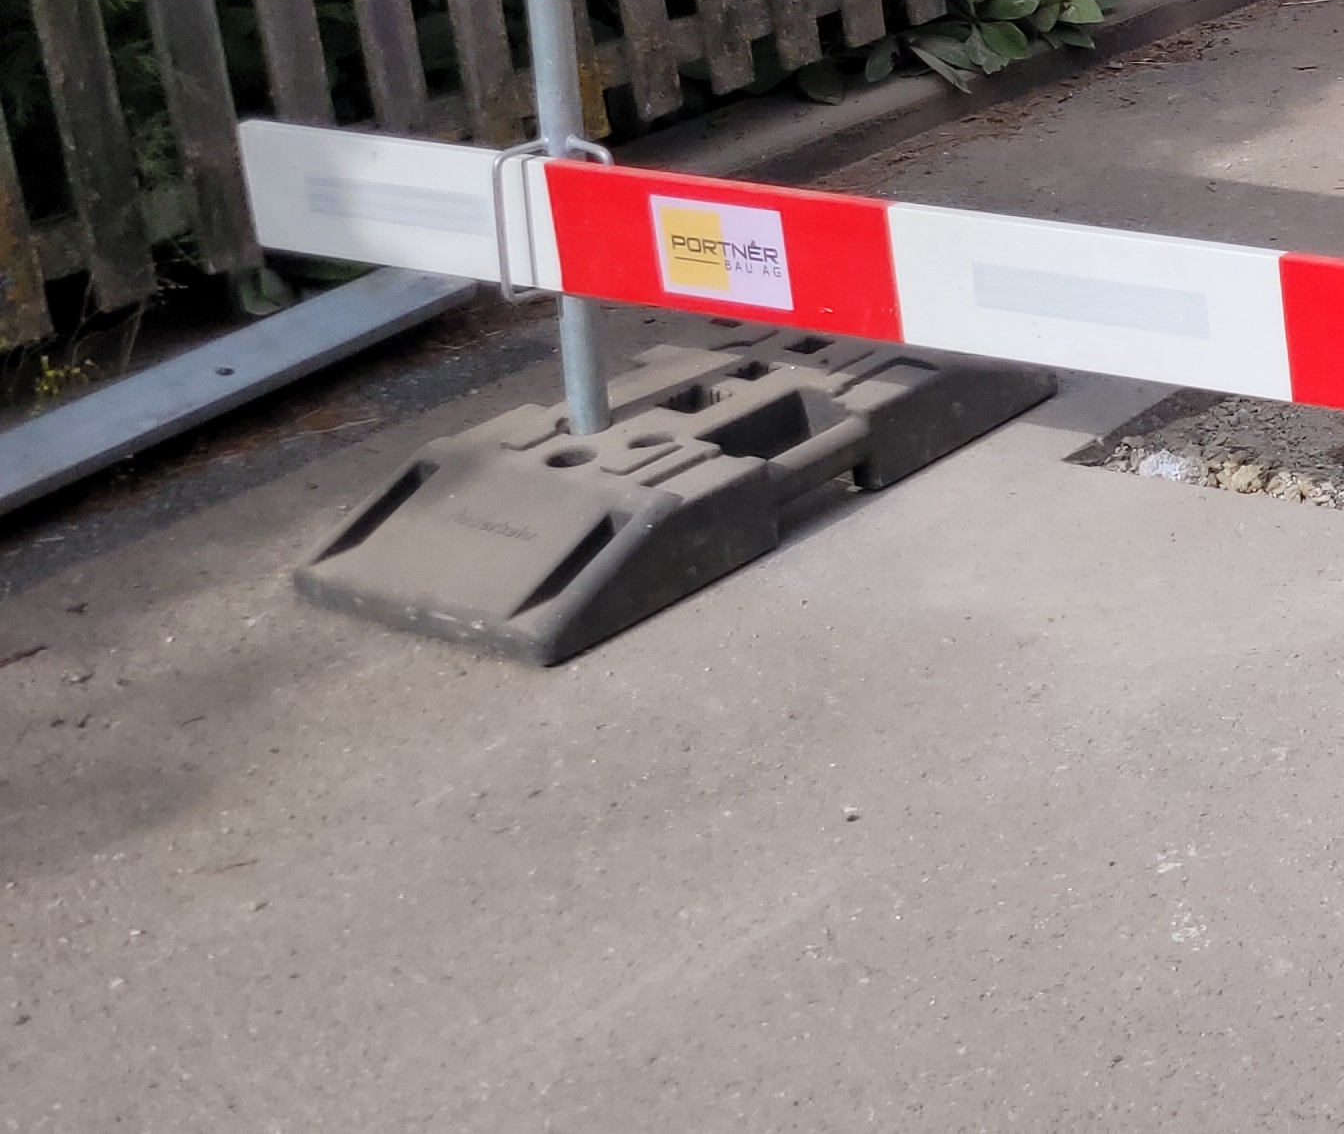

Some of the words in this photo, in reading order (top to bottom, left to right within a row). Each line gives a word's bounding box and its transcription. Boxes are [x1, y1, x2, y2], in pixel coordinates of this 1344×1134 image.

[671, 234, 780, 265] PORTNER
[724, 259, 753, 274] BAU
[762, 265, 782, 278] AG
